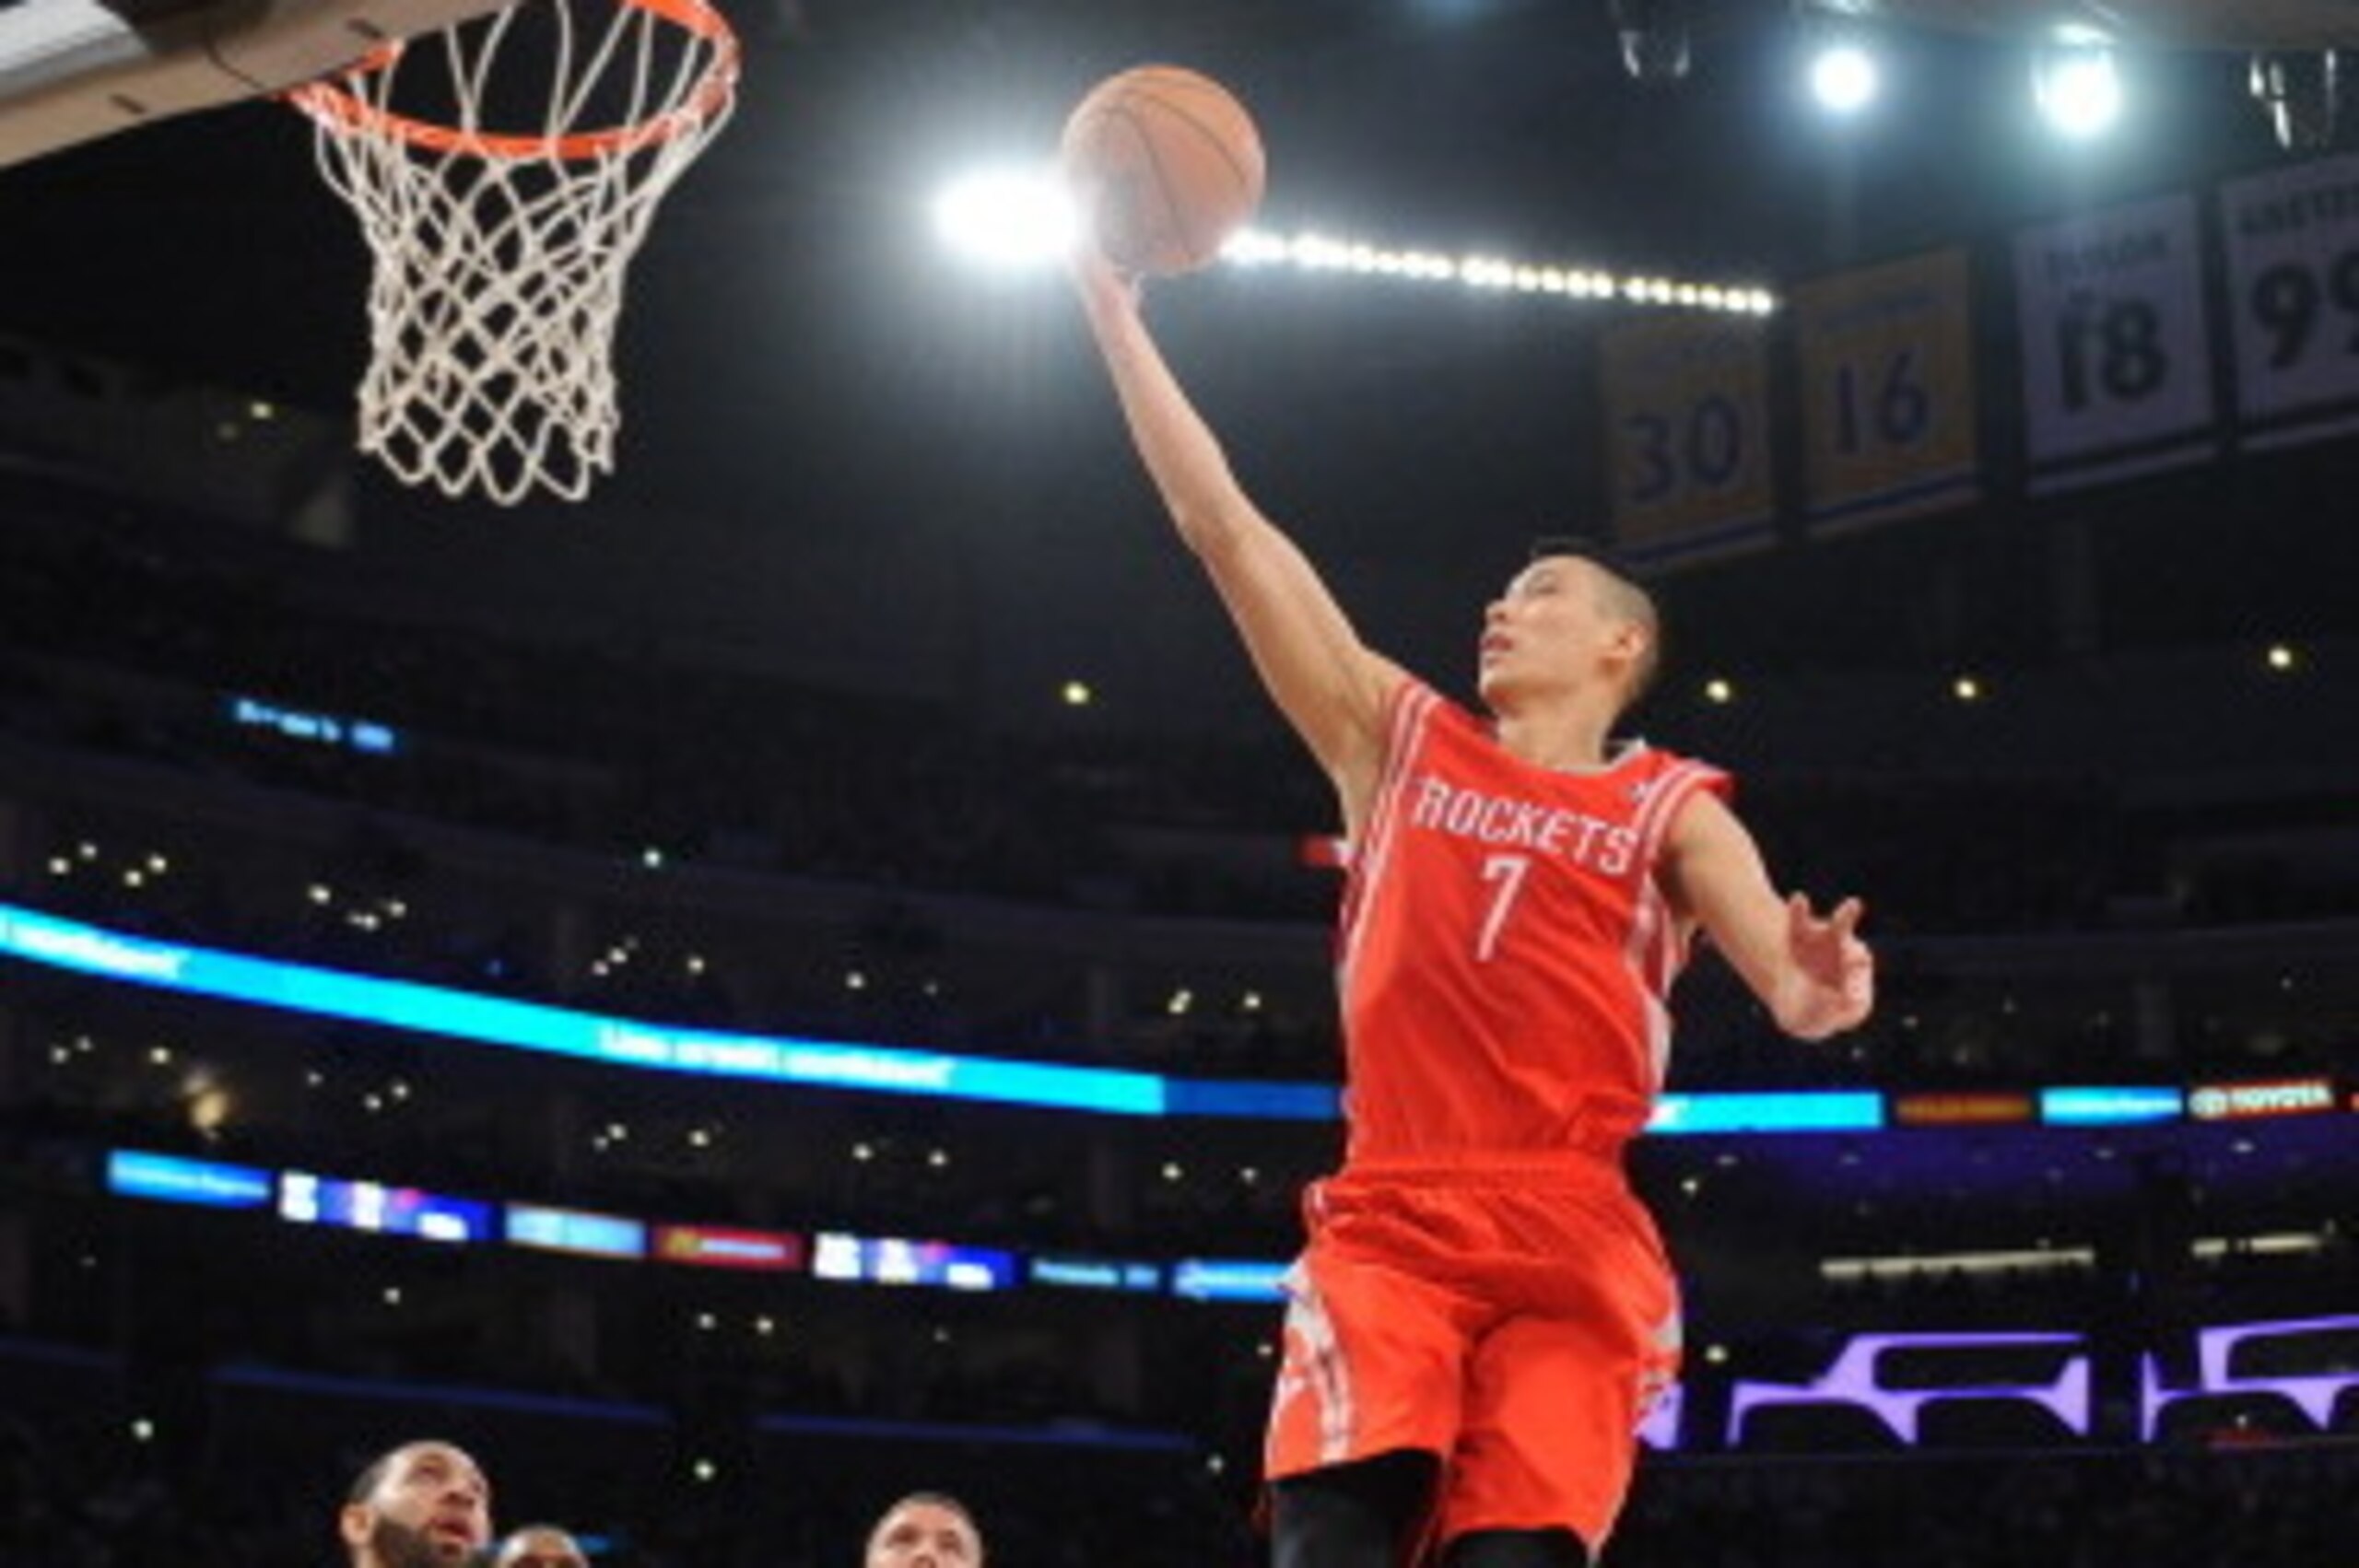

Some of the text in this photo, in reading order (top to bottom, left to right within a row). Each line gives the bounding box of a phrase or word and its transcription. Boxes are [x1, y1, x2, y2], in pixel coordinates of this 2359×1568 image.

[1625, 392, 1743, 505] 30
[1835, 346, 1930, 458] 16
[1412, 776, 1641, 876] ROCKETS
[1476, 853, 1531, 963] 7
